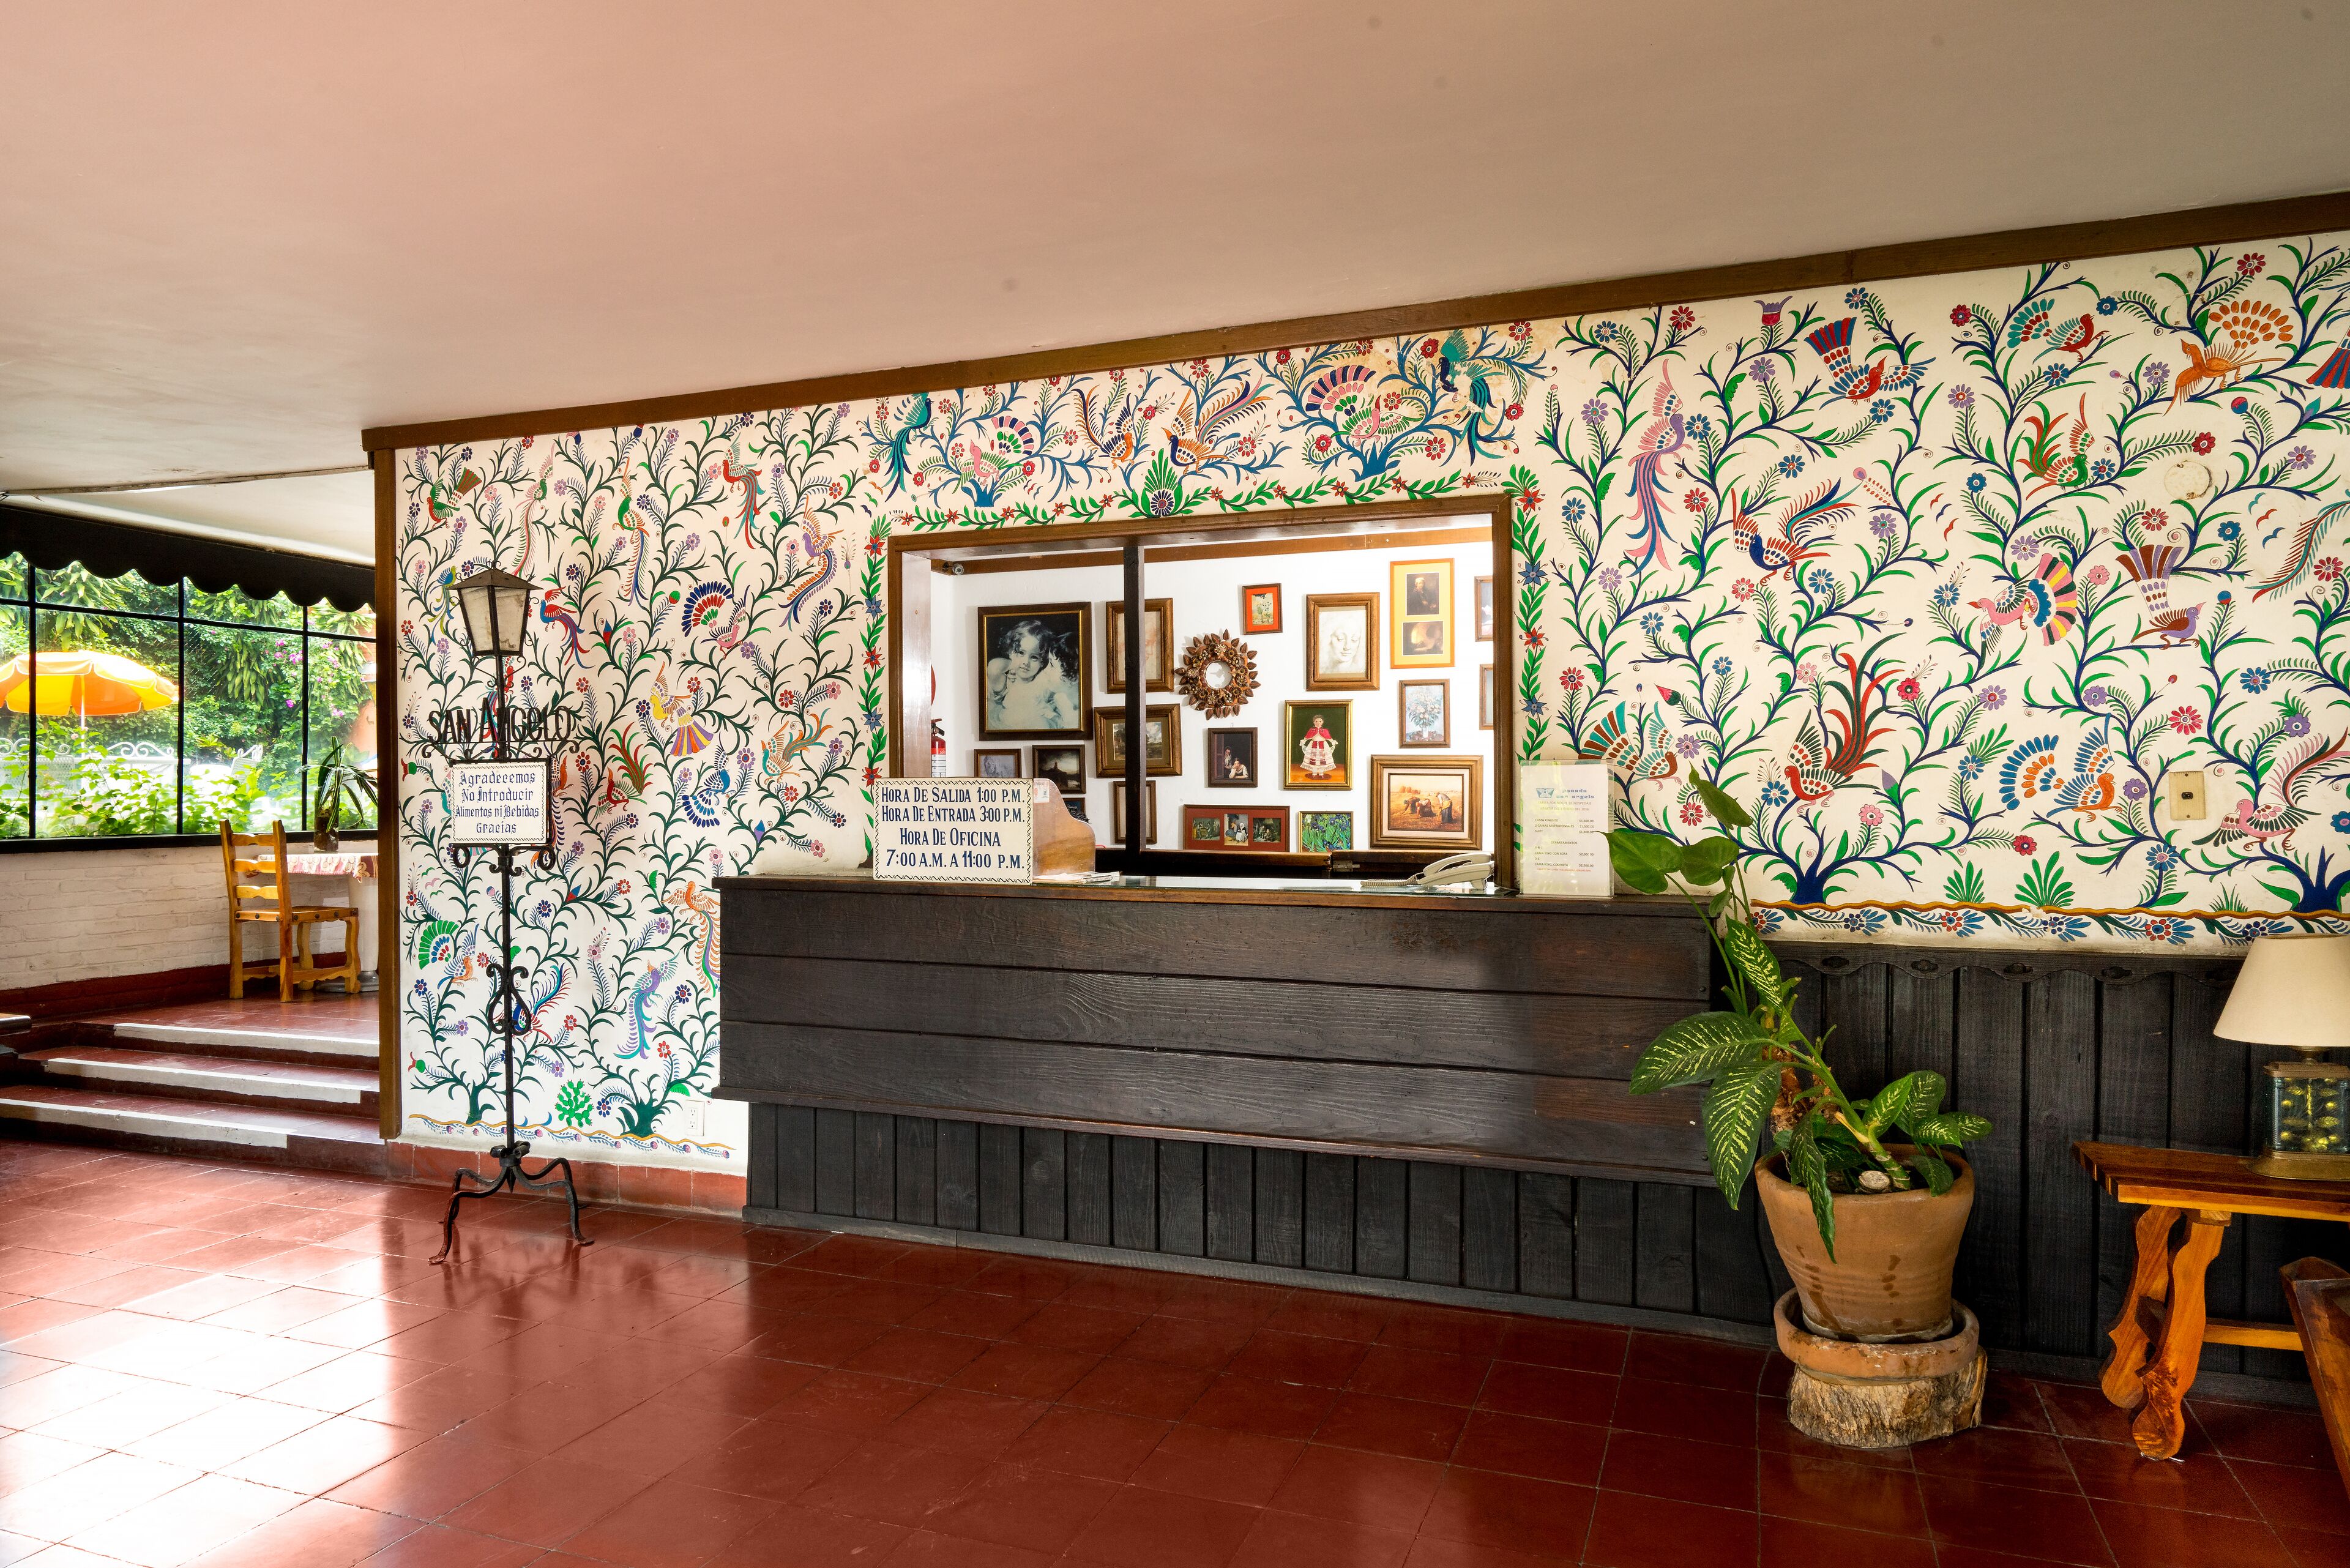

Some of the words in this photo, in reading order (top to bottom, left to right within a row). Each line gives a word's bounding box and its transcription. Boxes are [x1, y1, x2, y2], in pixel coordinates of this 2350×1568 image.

[428, 709, 471, 743] SAN
[459, 771, 535, 788] Agradecemos
[462, 788, 475, 803] No
[477, 786, 534, 802] Introducir
[881, 787, 909, 802] HORA
[914, 787, 928, 802] DE
[932, 787, 971, 802] SALIDA
[977, 787, 997, 802] 1:00
[1002, 788, 1025, 803] P.M.
[455, 805, 492, 818] Alimentos
[494, 805, 502, 818] ni
[504, 804, 539, 819] Bebidas
[882, 805, 909, 822] HORA
[913, 805, 925, 822] DE
[928, 806, 976, 822] ENTRADA
[980, 807, 1001, 822] 3:00
[1004, 807, 1025, 823] P.M.
[476, 821, 517, 834] Gracias
[900, 828, 929, 845] HORA
[933, 828, 946, 846] DE
[950, 828, 1001, 846] OFICINA
[886, 849, 916, 867] 7:00
[919, 853, 946, 867] A.M.
[950, 853, 958, 867] A
[962, 851, 991, 868] 11:00
[998, 854, 1024, 868] P.M.
